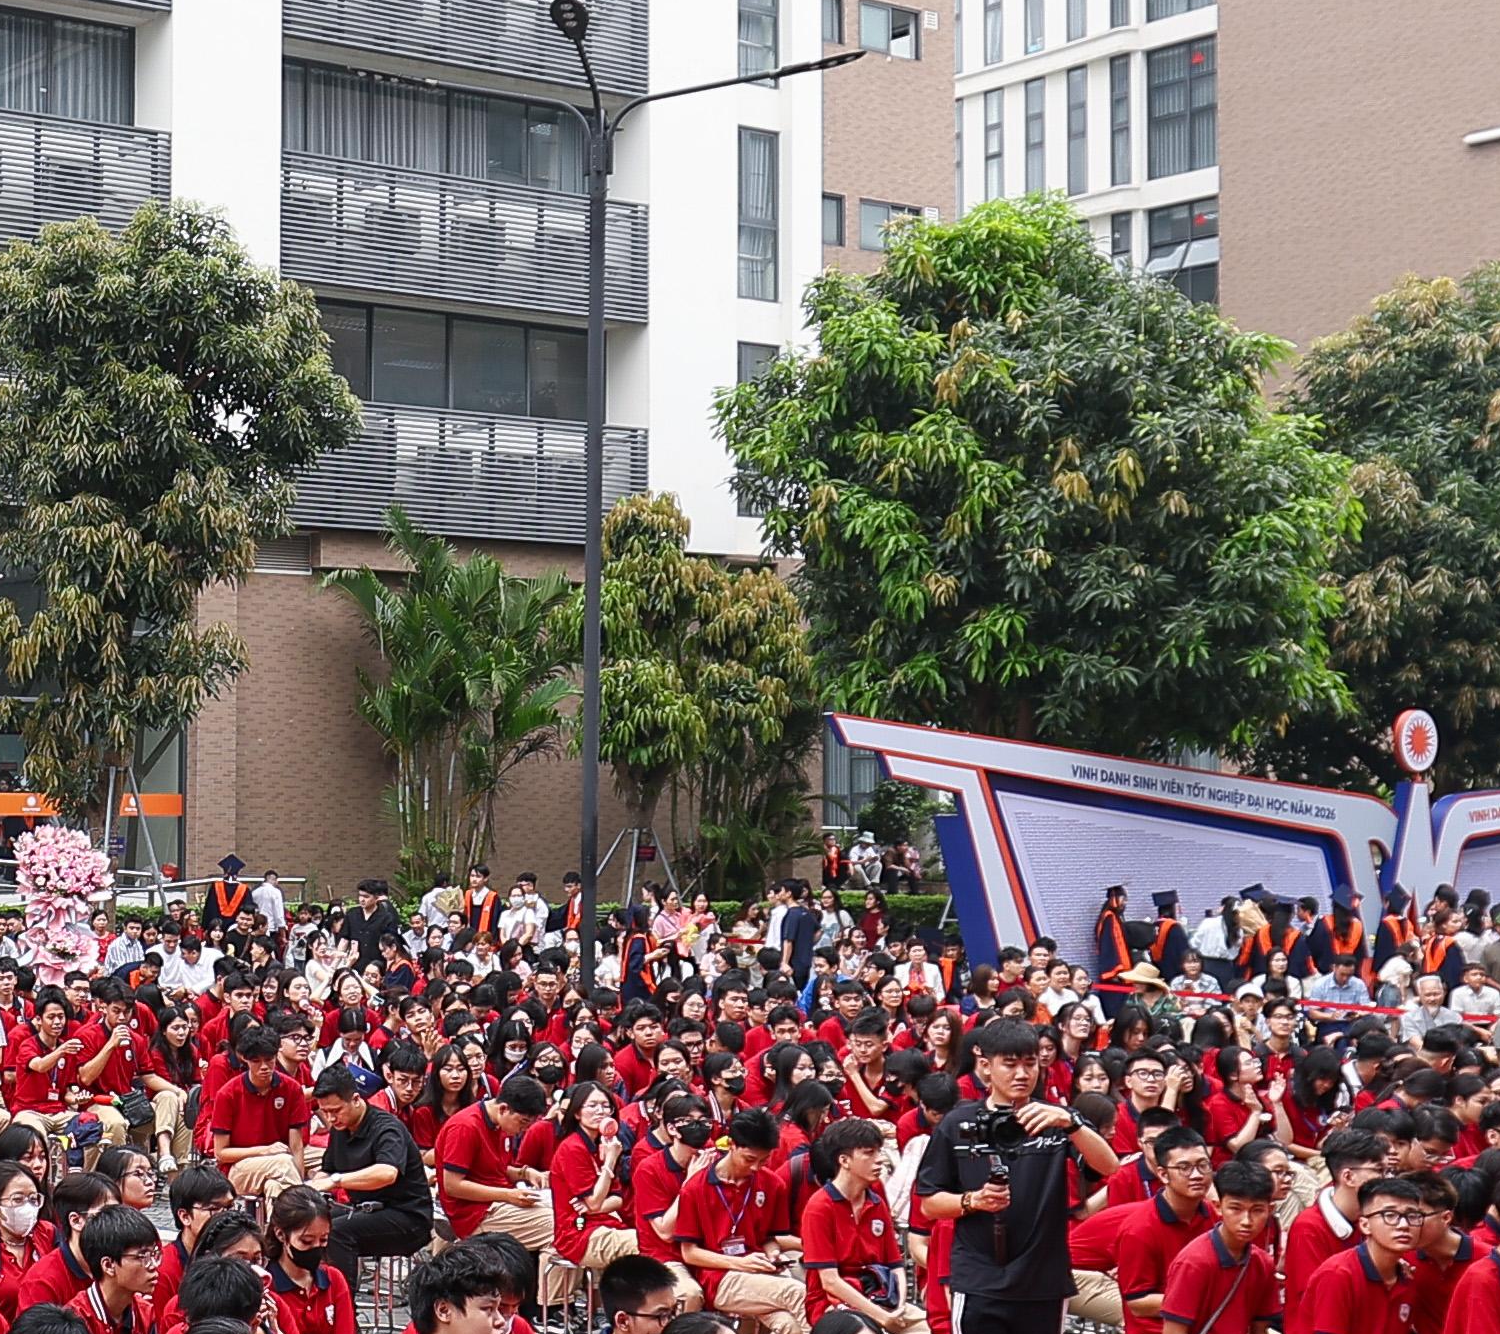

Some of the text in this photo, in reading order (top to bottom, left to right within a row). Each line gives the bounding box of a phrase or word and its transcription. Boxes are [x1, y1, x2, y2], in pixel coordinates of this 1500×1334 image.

[1071, 764, 1336, 820] VINH DANH SINH VIÊN TỐT NGHIỆP ĐẠI HỌC NĂM 2026
[1468, 809, 1491, 823] VINH
